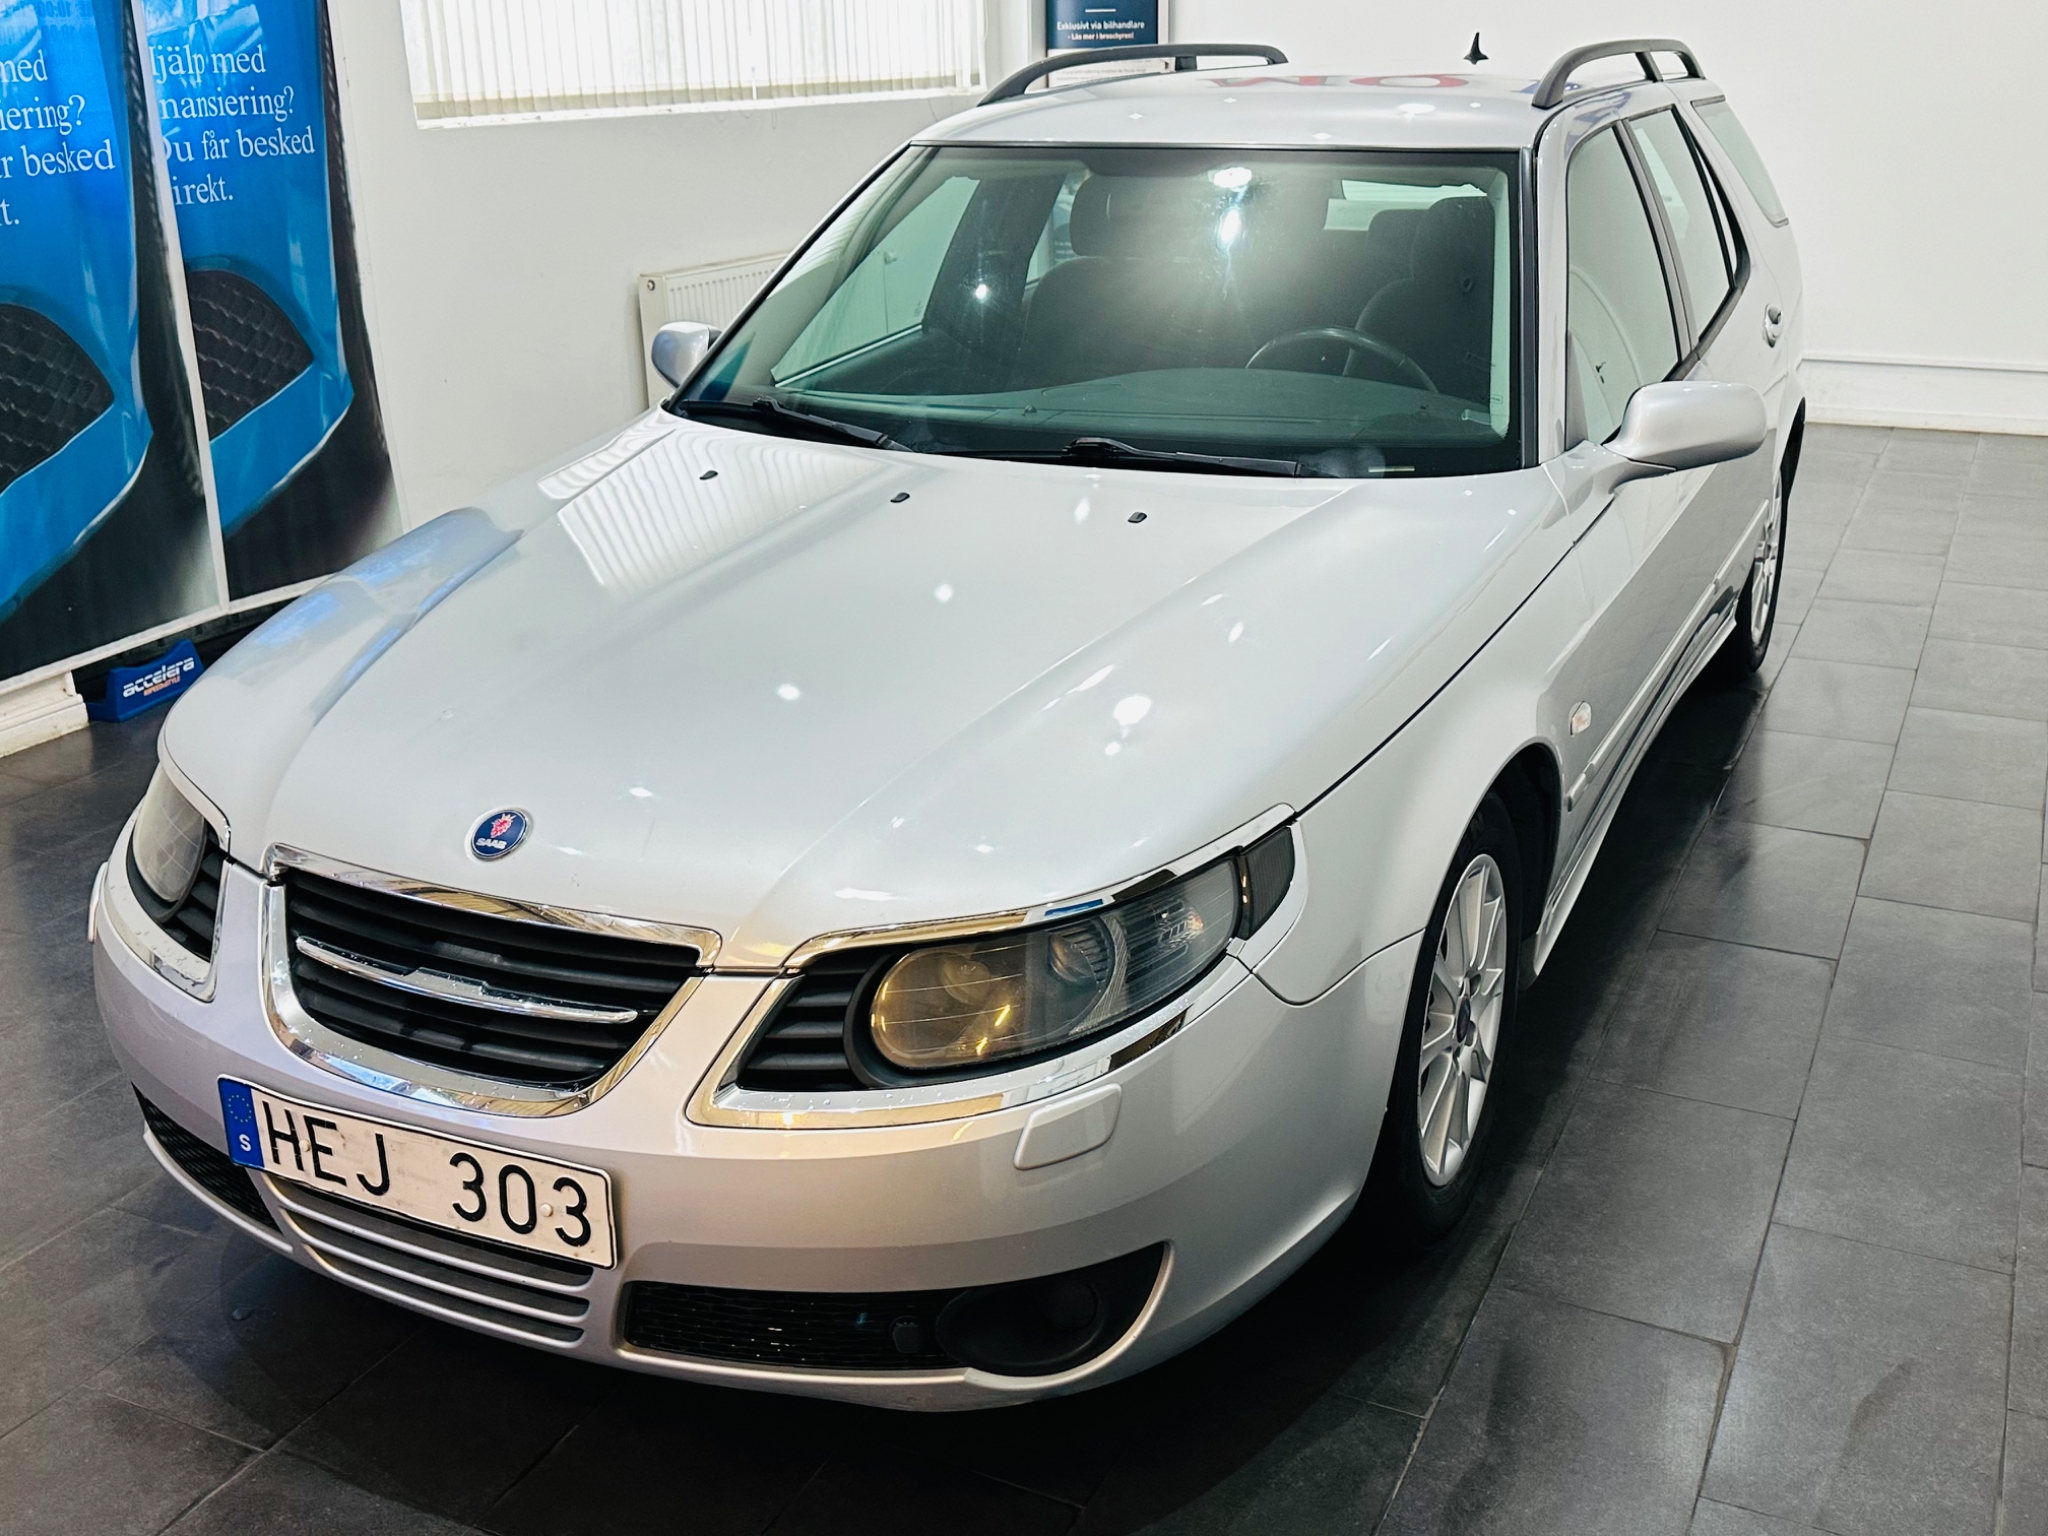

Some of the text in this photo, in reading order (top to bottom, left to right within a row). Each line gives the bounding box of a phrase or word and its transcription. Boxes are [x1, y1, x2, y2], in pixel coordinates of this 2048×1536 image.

[1057, 20, 1145, 30] Exklusivt via bilhandlare
[211, 44, 267, 74] med
[0, 94, 86, 136] iering?
[159, 86, 295, 122] nansiering?
[20, 139, 116, 177] besked
[202, 130, 231, 160] får
[236, 125, 316, 158] besked
[172, 173, 234, 206] irekt.
[123, 656, 195, 698] accelera
[475, 837, 508, 850] SAAB
[238, 1133, 252, 1153] S
[261, 1100, 592, 1248] HEJ 303
